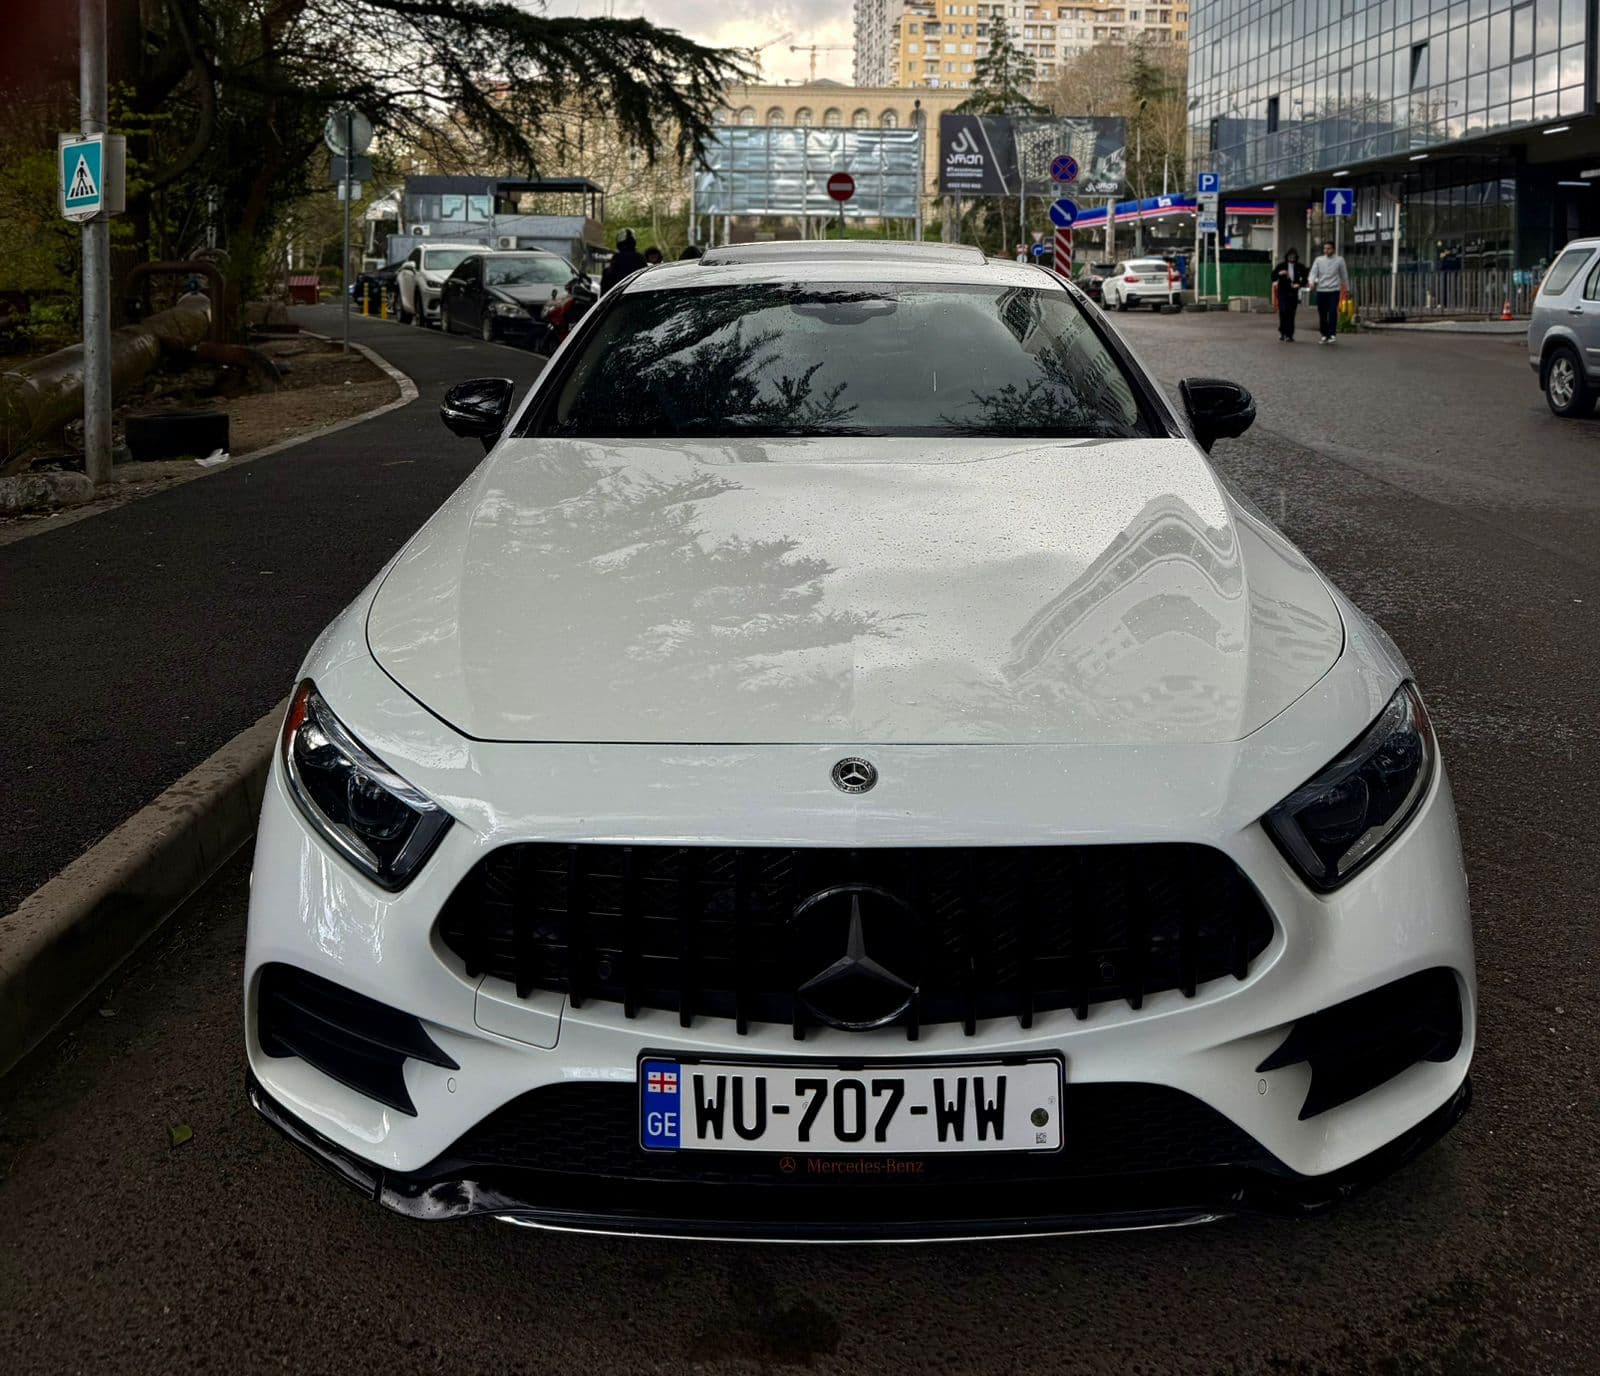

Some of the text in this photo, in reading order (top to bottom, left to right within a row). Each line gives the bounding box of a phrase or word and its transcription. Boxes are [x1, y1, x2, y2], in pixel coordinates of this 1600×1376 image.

[1202, 174, 1215, 191] P
[692, 1074, 1007, 1143] WU-707-WW
[647, 1111, 678, 1138] GE
[807, 1158, 924, 1174] Mercedes-Benz
